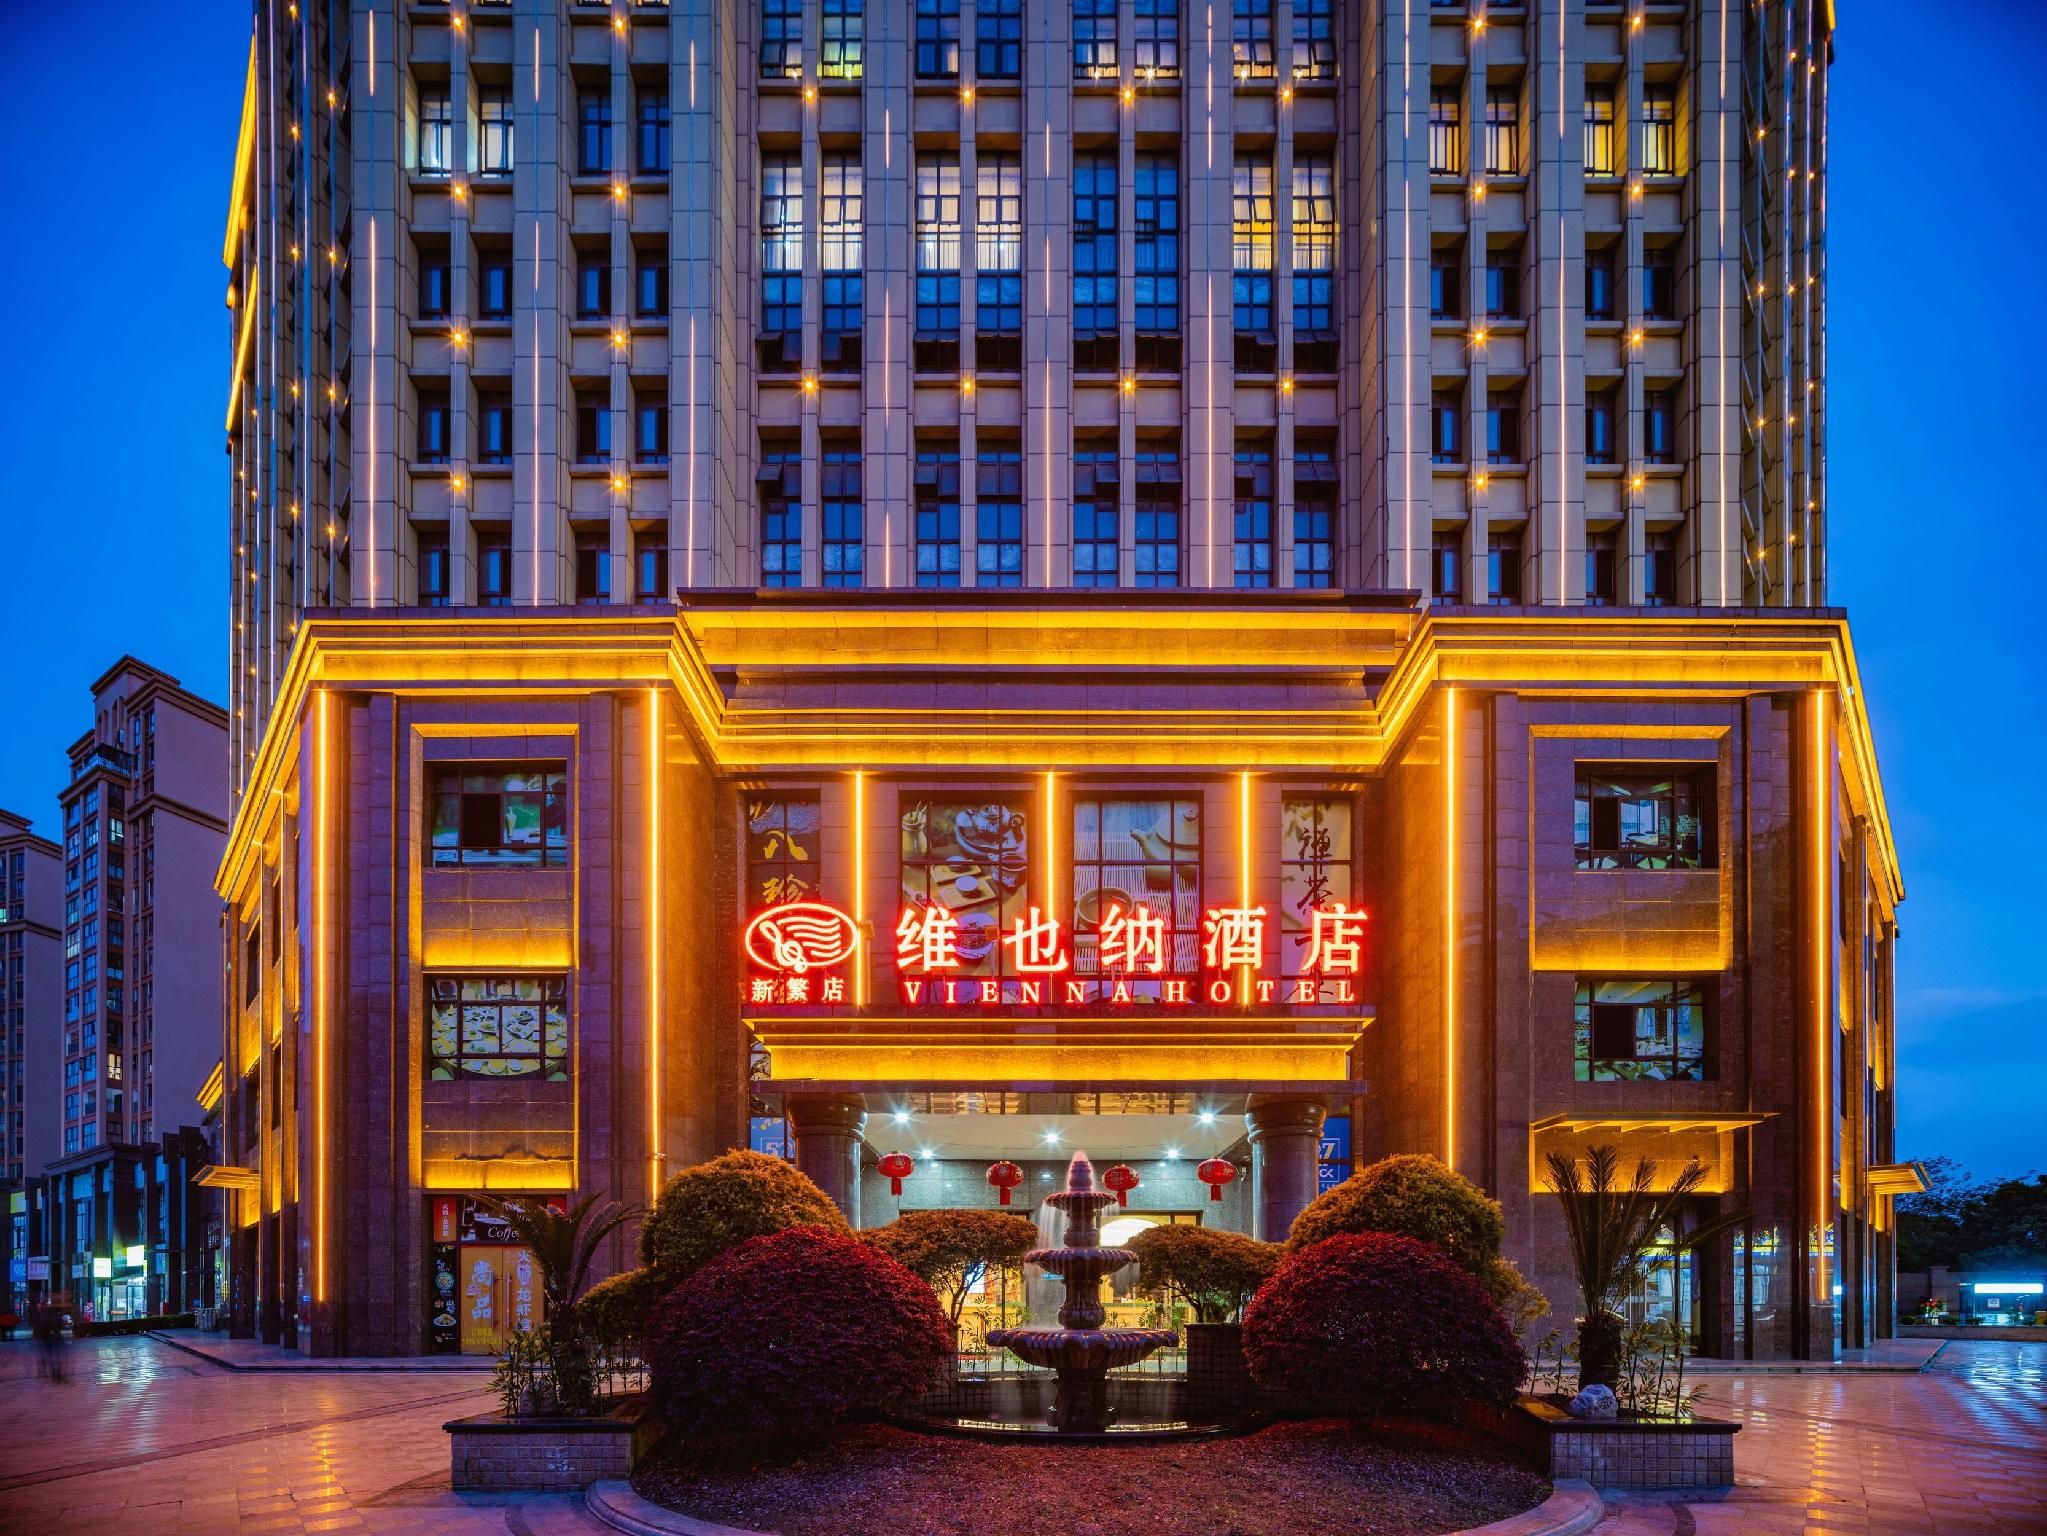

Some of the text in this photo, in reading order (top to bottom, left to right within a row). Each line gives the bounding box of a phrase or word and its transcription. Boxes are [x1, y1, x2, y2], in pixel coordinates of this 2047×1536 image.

[896, 904, 1368, 974] 维也纳酒店
[752, 978, 844, 1002] 新繁店
[906, 980, 1356, 1003] VIENNA HOTEL
